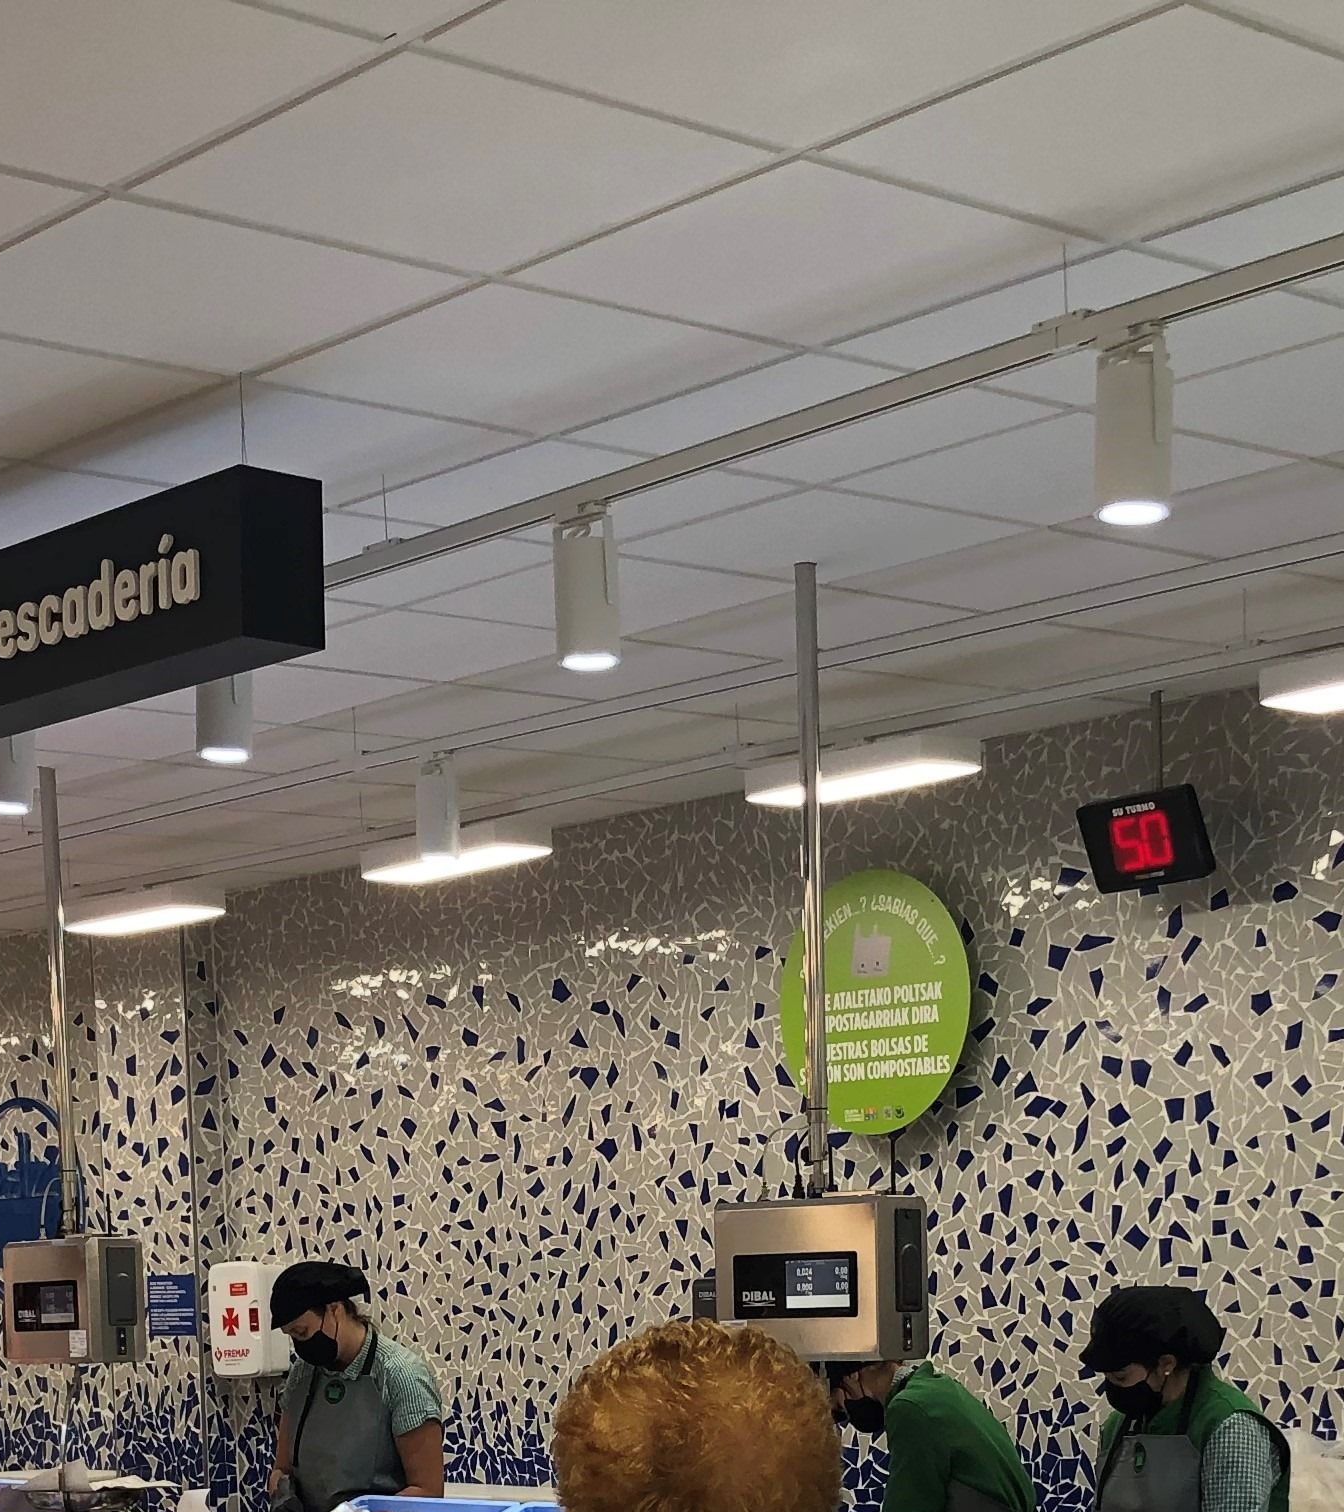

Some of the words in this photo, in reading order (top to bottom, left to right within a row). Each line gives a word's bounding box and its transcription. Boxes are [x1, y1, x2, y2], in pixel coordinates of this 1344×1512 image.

[1112, 808, 1124, 817] SU
[1125, 802, 1155, 815] TURNO
[1111, 810, 1174, 873] 50
[833, 988, 892, 1012] ATALETAKO
[894, 981, 943, 1004] POLTSAK
[912, 1004, 939, 1025] DIRA
[826, 1040, 869, 1062] UESTRAS
[871, 1036, 912, 1058] BOLSAS
[914, 1034, 929, 1054] DE
[843, 1063, 866, 1083] SON
[867, 1055, 951, 1080] COMPOSTABLES
[742, 1290, 776, 1302] DIBAL
[224, 1348, 250, 1359] FREMAP
